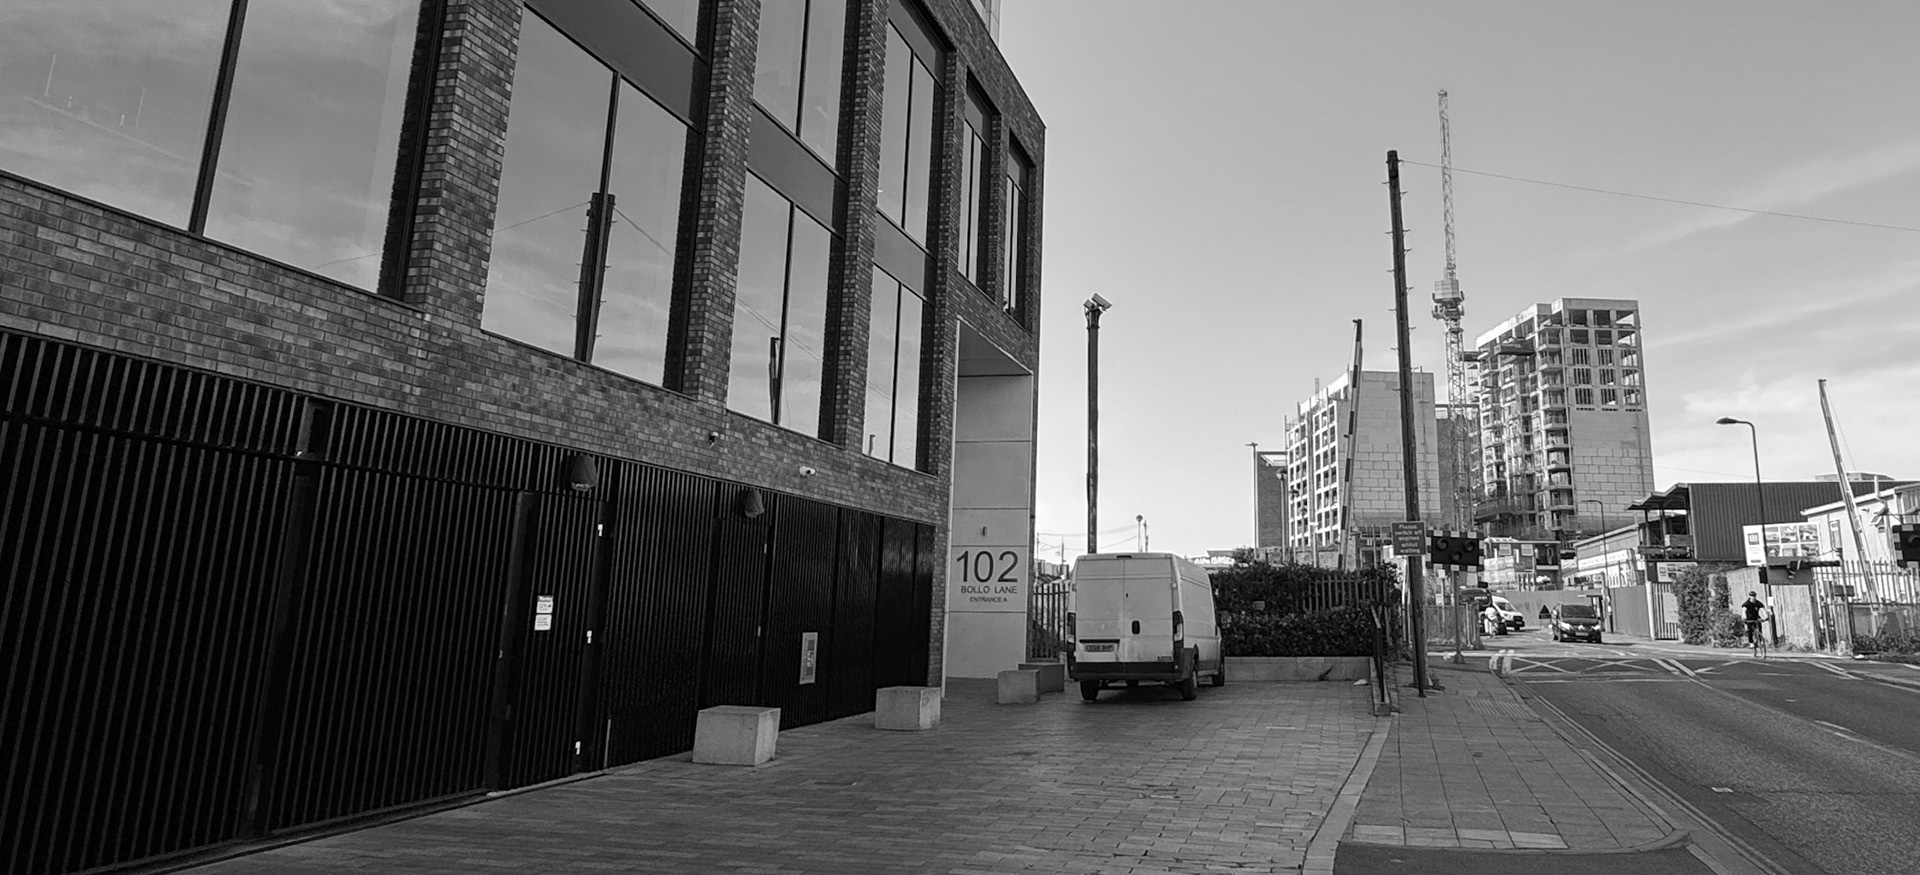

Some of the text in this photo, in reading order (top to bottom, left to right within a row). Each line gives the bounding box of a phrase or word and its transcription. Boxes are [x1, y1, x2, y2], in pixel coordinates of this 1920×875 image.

[957, 551, 1018, 582] 102
[961, 586, 1018, 594] BOLLO LANE
